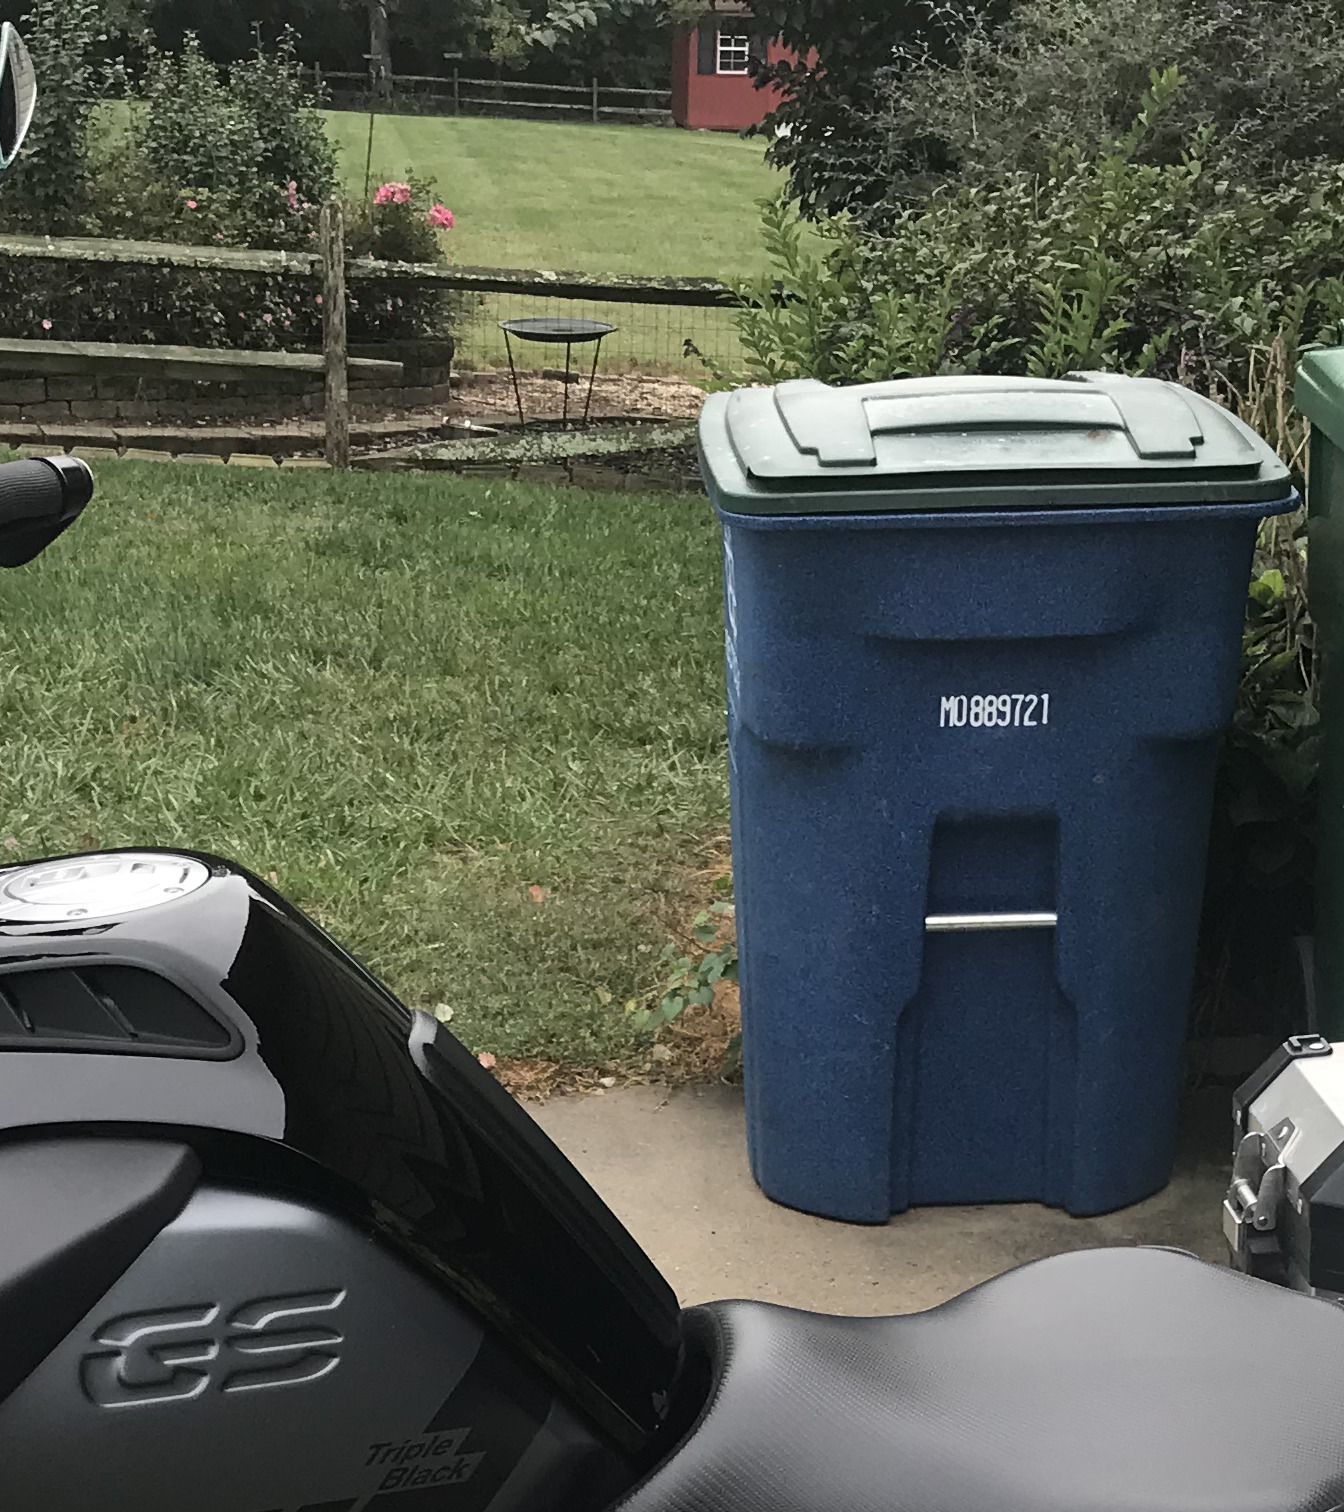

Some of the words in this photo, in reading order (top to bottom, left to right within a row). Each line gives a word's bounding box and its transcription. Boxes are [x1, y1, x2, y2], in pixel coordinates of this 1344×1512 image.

[78, 1287, 348, 1409] GS
[364, 1434, 455, 1466] Triple
[376, 1457, 472, 1492] Black
